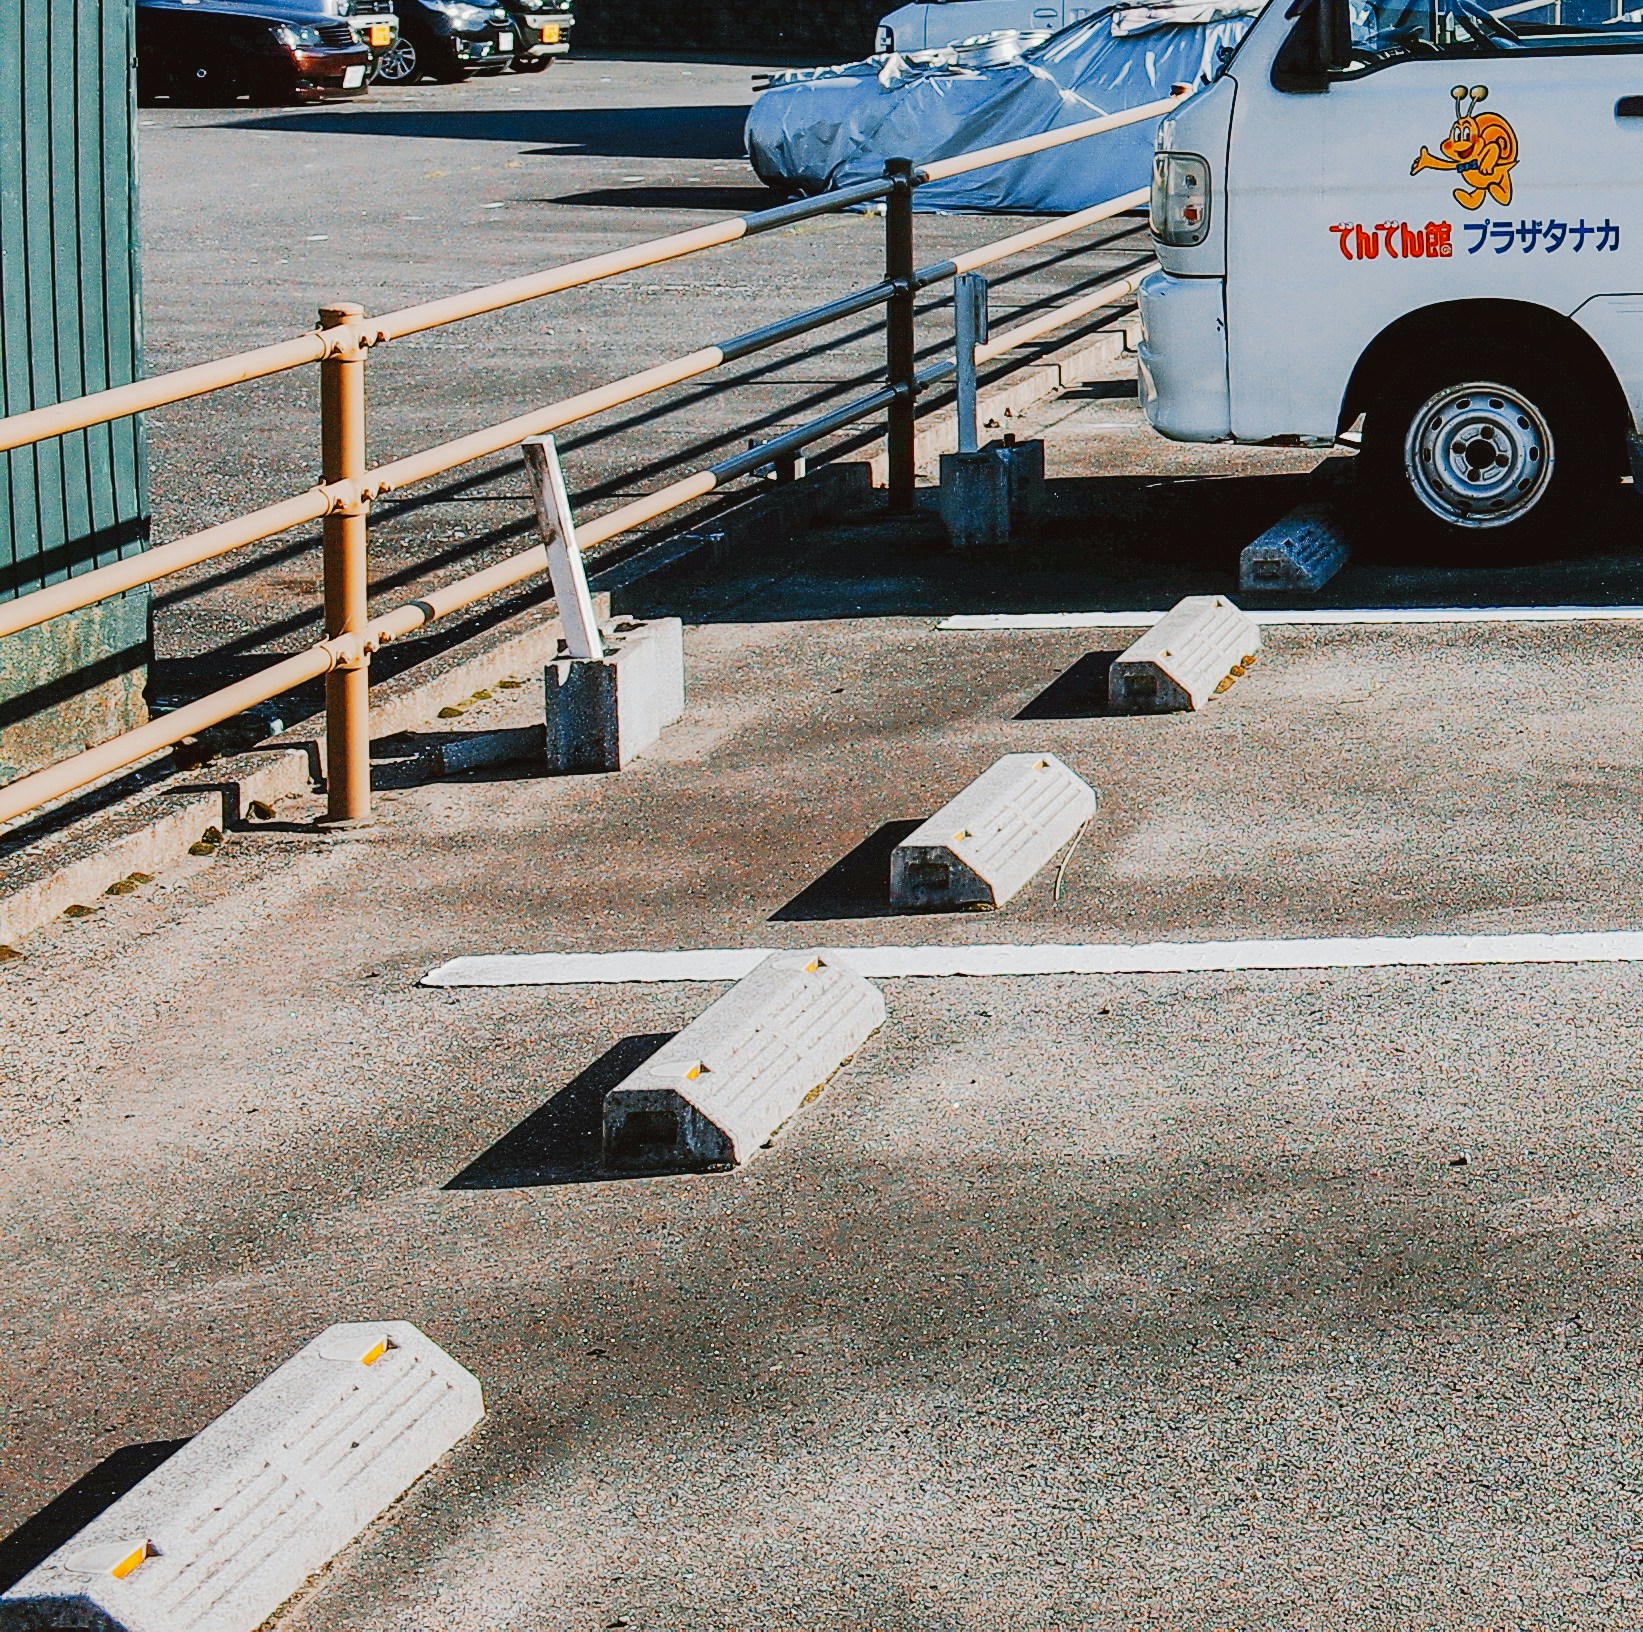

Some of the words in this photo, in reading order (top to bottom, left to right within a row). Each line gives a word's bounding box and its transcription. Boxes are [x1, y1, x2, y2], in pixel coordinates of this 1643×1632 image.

[1329, 220, 1452, 260] でんでん館
[1463, 218, 1620, 255] プラザタナカ
